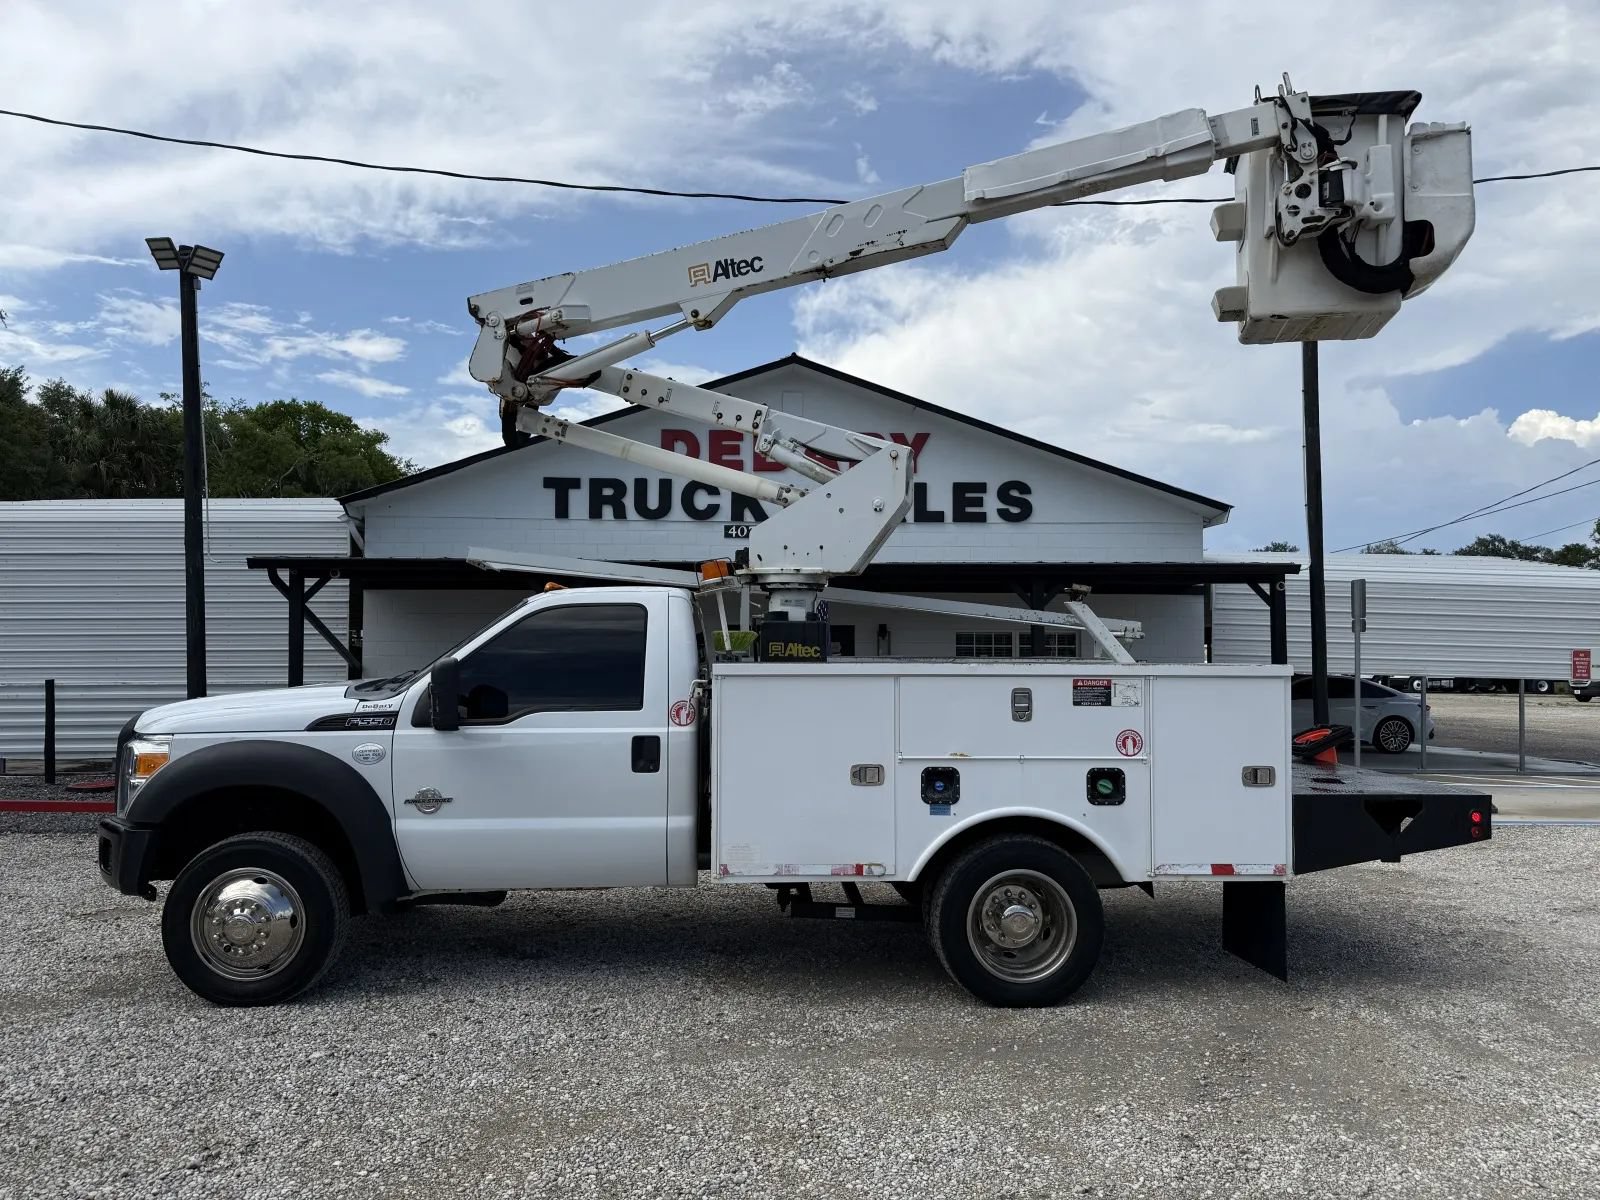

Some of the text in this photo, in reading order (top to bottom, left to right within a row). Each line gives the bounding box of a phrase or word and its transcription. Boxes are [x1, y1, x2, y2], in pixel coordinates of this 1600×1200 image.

[712, 256, 763, 282] Altec
[661, 429, 931, 474] DEY
[902, 480, 1033, 523] LES
[785, 642, 820, 657] Altec
